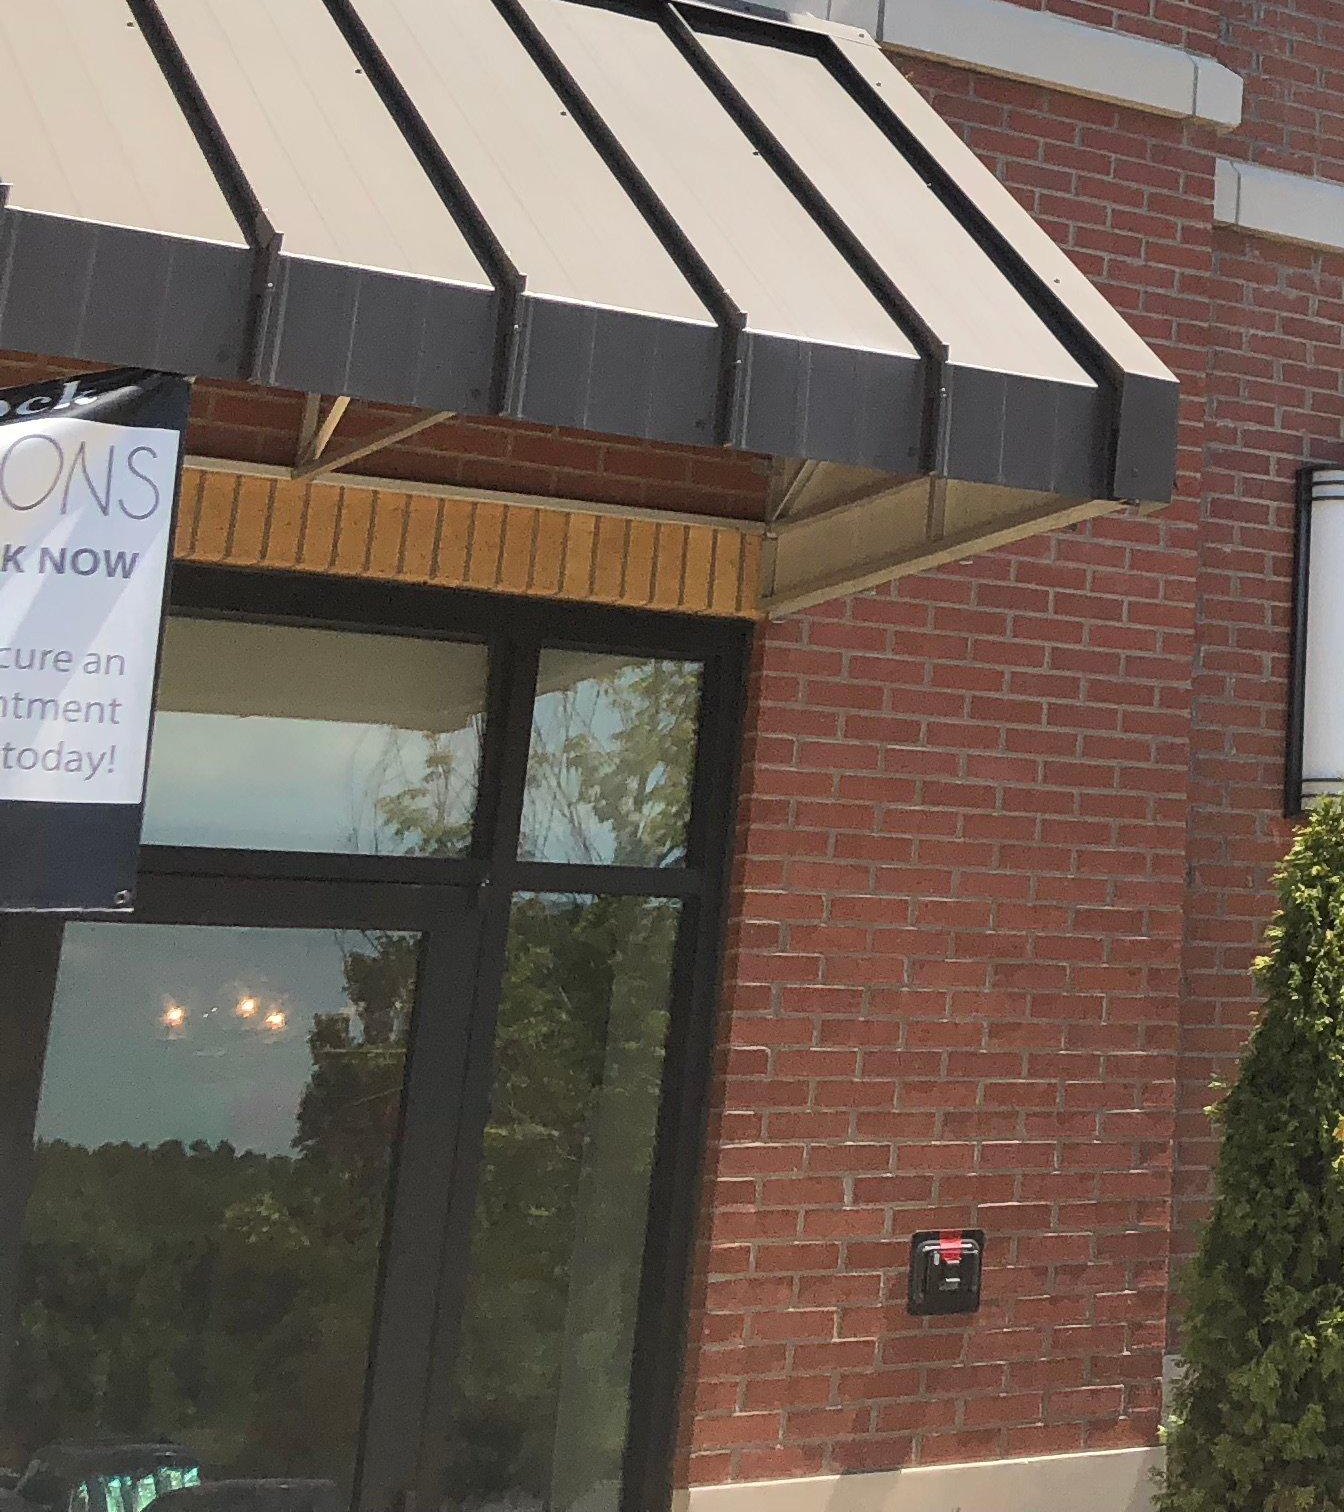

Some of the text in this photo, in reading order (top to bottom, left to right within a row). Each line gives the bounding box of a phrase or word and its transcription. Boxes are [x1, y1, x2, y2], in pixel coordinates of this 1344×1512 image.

[0, 434, 160, 520] ONS
[38, 545, 140, 580] NOW
[83, 652, 126, 676] an
[2, 740, 117, 782] today!
